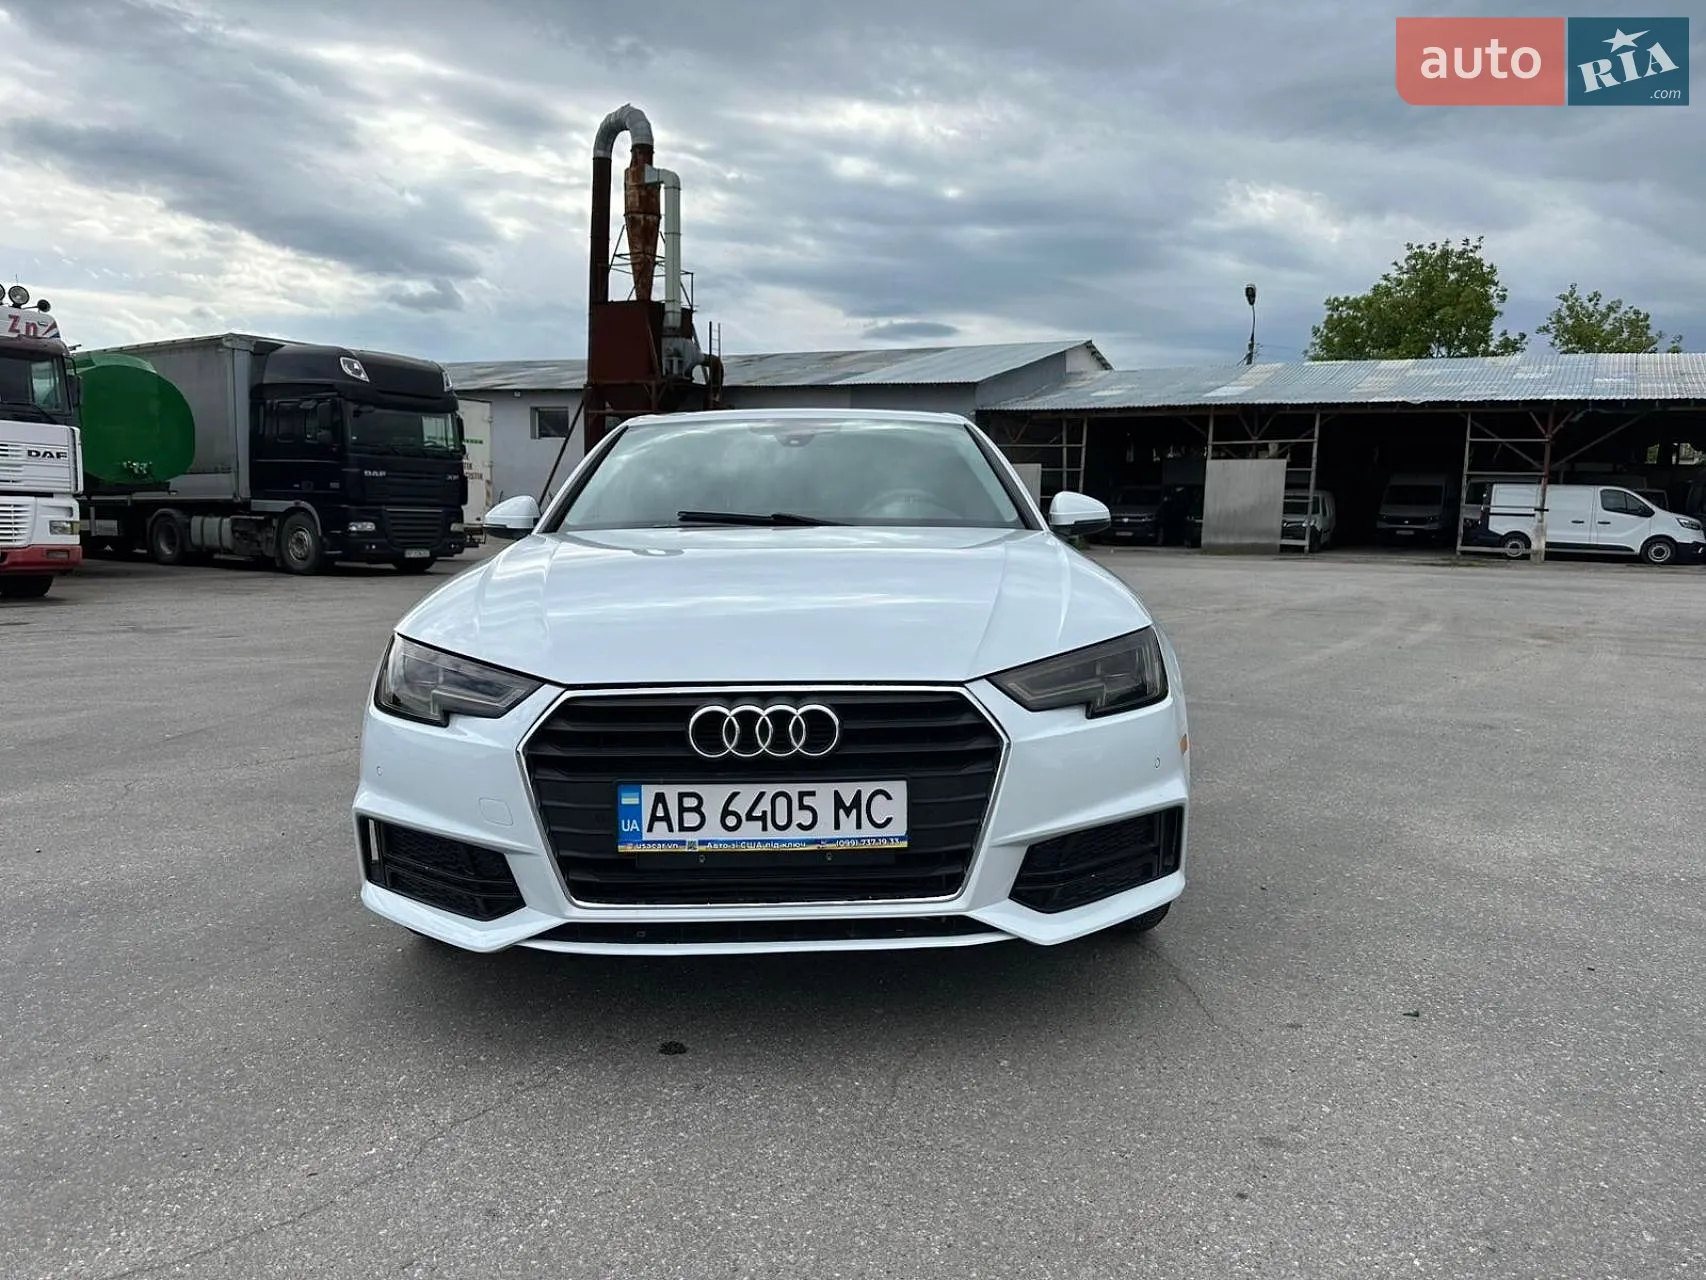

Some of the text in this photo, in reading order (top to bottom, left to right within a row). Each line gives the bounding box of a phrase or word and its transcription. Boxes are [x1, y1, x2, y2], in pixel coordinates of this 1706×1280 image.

[27, 449, 68, 459] DAF
[646, 788, 894, 833] AB 6405 MC
[621, 819, 641, 832] UA
